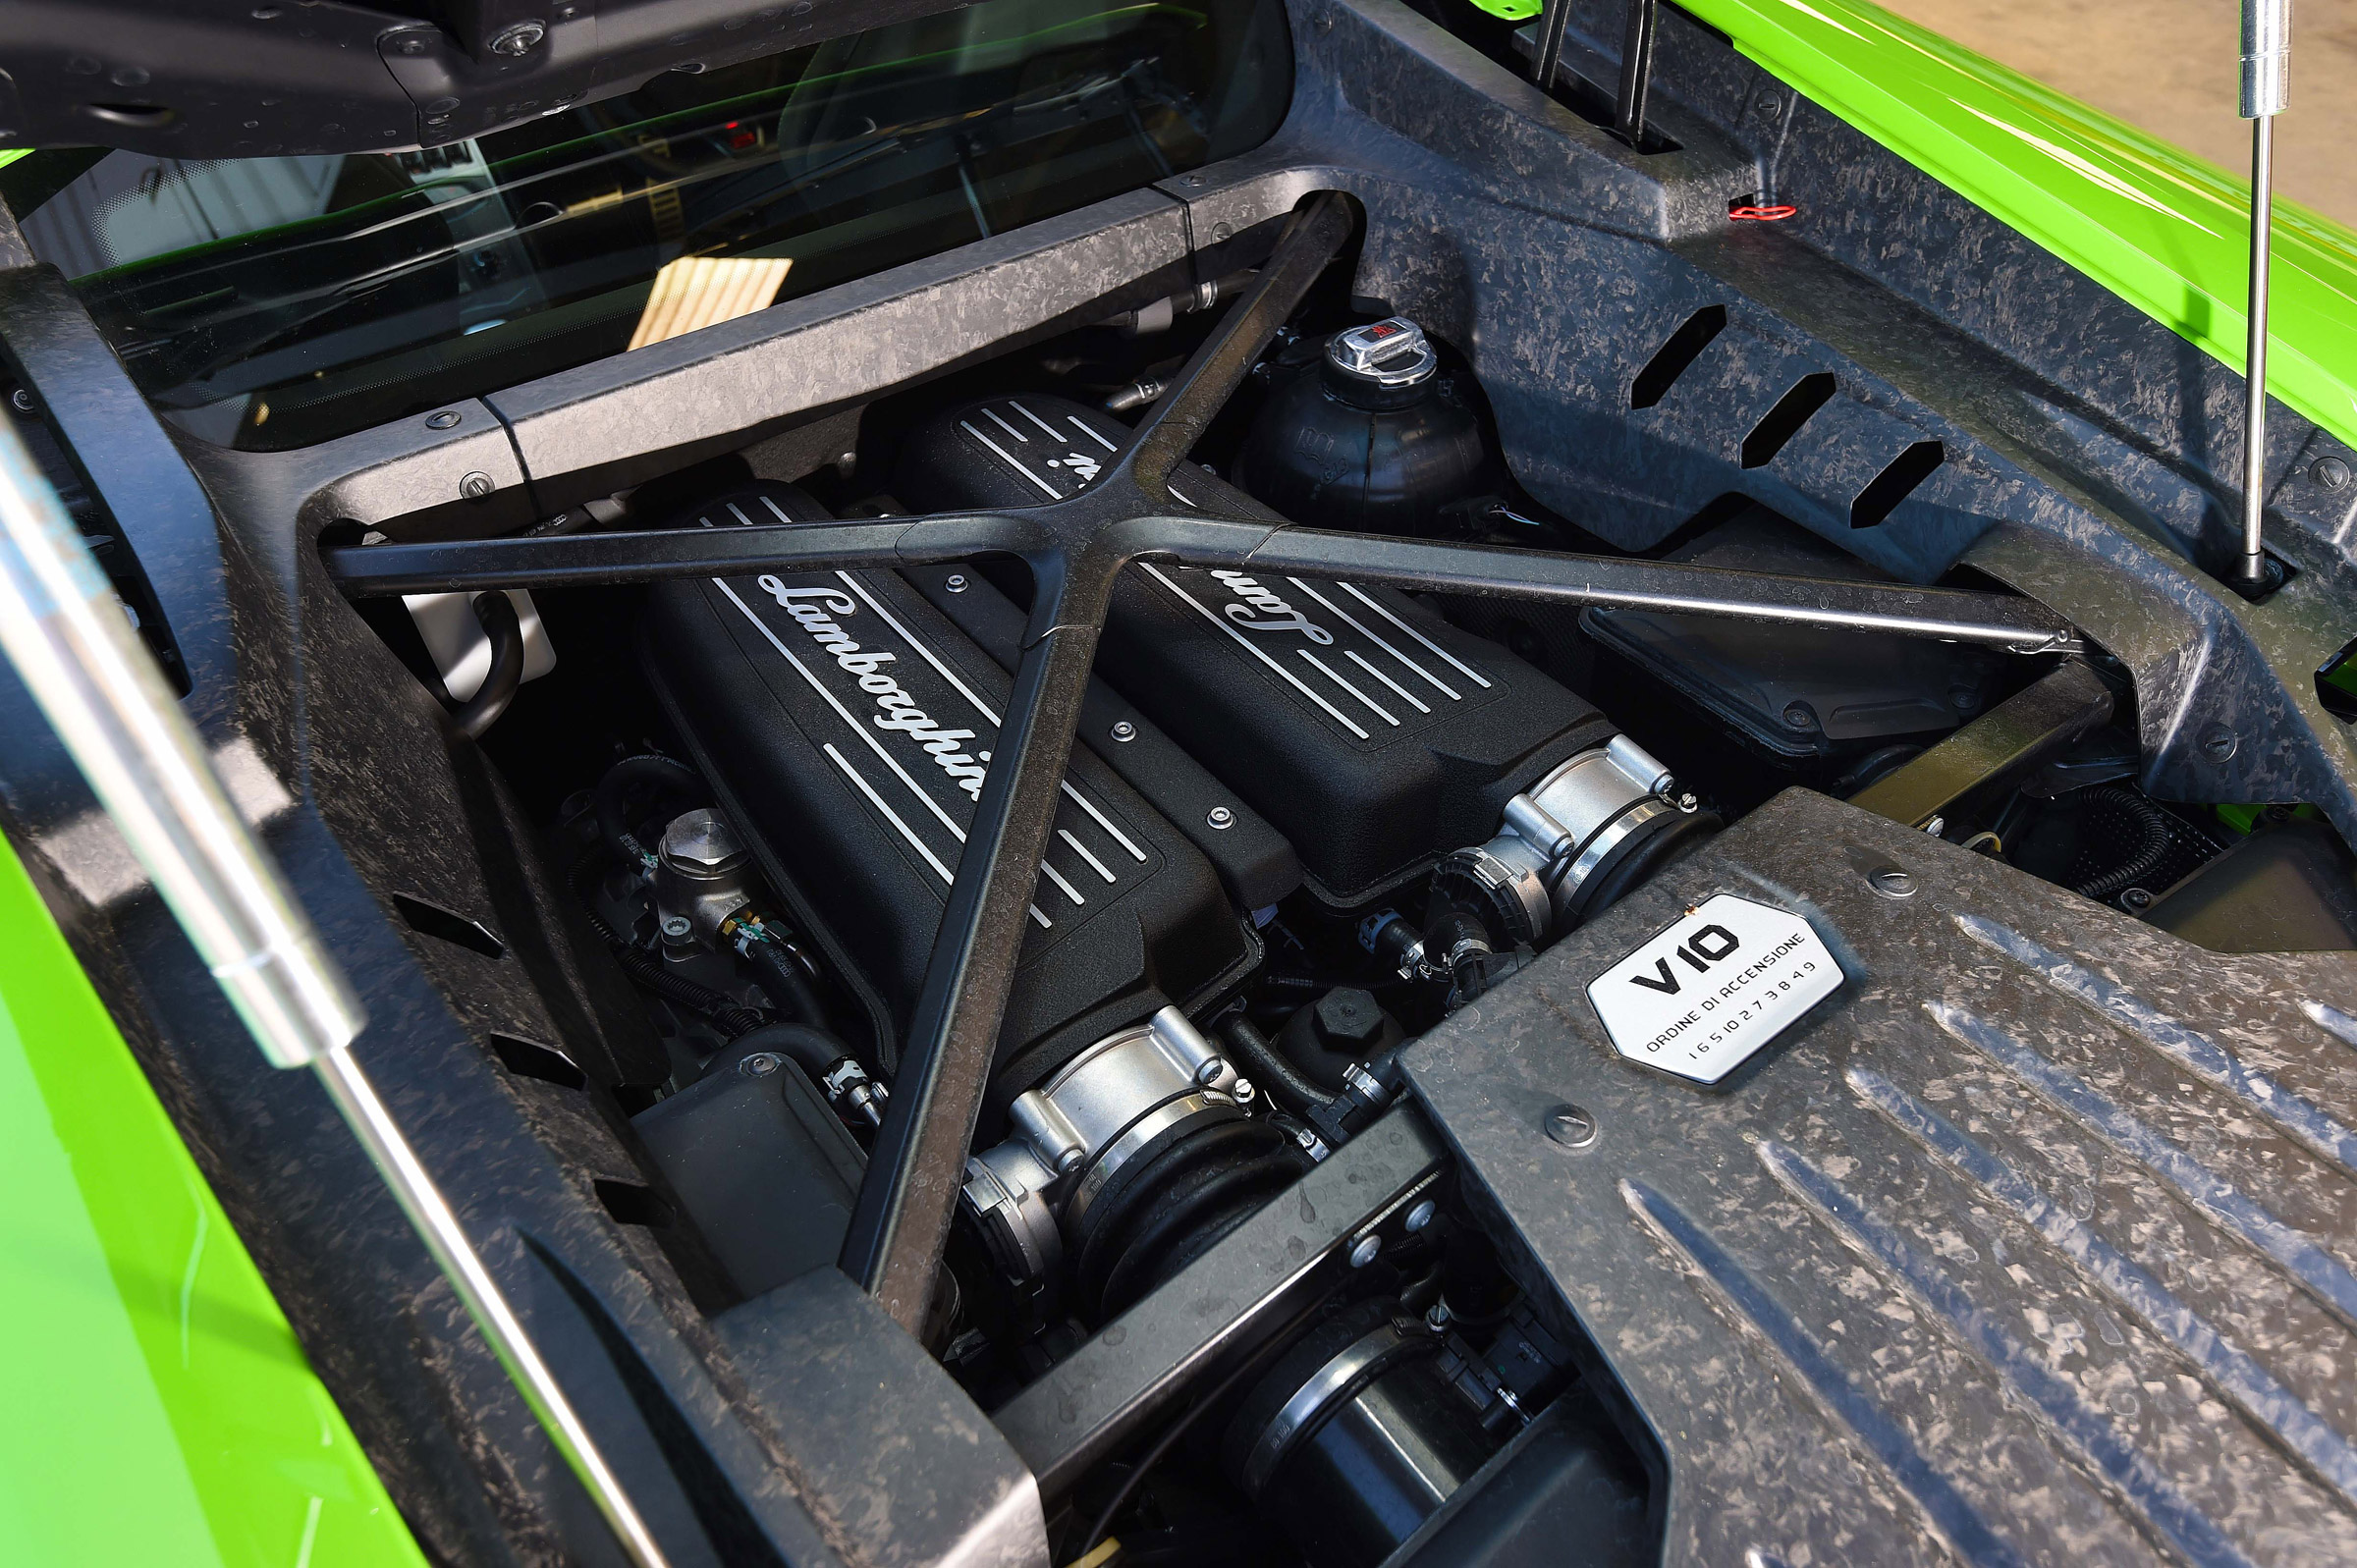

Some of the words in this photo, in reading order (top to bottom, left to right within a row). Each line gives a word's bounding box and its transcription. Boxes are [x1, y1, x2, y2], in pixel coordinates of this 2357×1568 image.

[757, 574, 992, 802] Lamborghin
[1628, 924, 1740, 996] V10
[1646, 1010, 1702, 1053] ORDINE
[1701, 997, 1721, 1011] DI
[1719, 932, 1806, 999] ACCENSIONE
[1696, 1043, 1710, 1054] 6
[1709, 1032, 1723, 1044] 5
[1723, 1020, 1740, 1034] 10
[1738, 1009, 1753, 1021] 2
[1751, 1000, 1763, 1010] 7
[1764, 990, 1779, 1000] 3
[1778, 980, 1791, 991] 8
[1792, 970, 1805, 979] 4
[1803, 961, 1816, 972] 9
